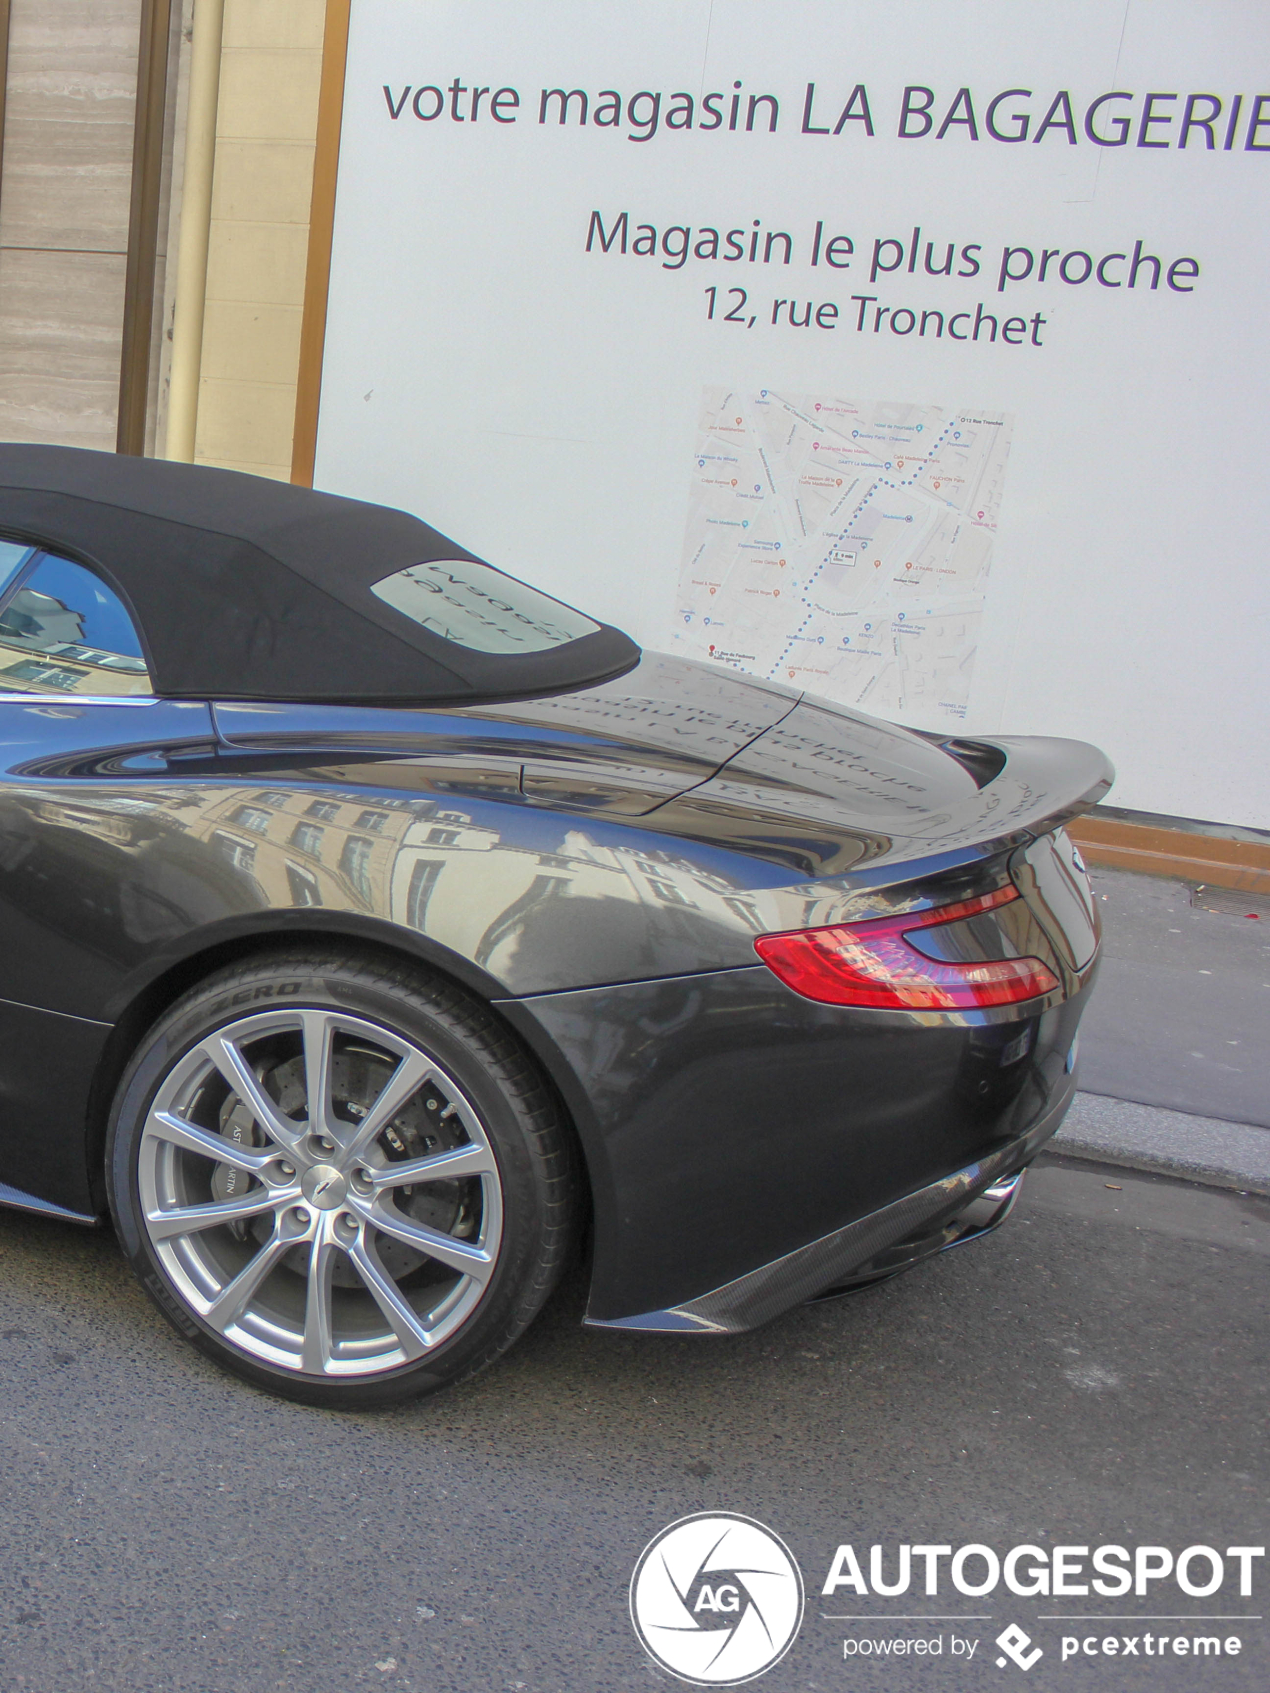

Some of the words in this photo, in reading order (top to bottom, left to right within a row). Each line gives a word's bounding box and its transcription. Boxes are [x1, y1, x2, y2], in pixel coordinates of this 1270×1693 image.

[382, 77, 520, 124] votre
[538, 80, 779, 143] magasin
[801, 82, 875, 137] LA
[897, 85, 1270, 152] BAGAGERIE
[585, 210, 792, 270] Magasin
[810, 220, 854, 269] le
[869, 226, 982, 283] plus
[997, 239, 1200, 293] proche
[704, 286, 757, 329] 12,
[771, 299, 839, 330] rue
[850, 295, 1047, 347] Tronchet
[210, 982, 303, 1016] ZERO
[226, 1166, 236, 1194] ARTIN
